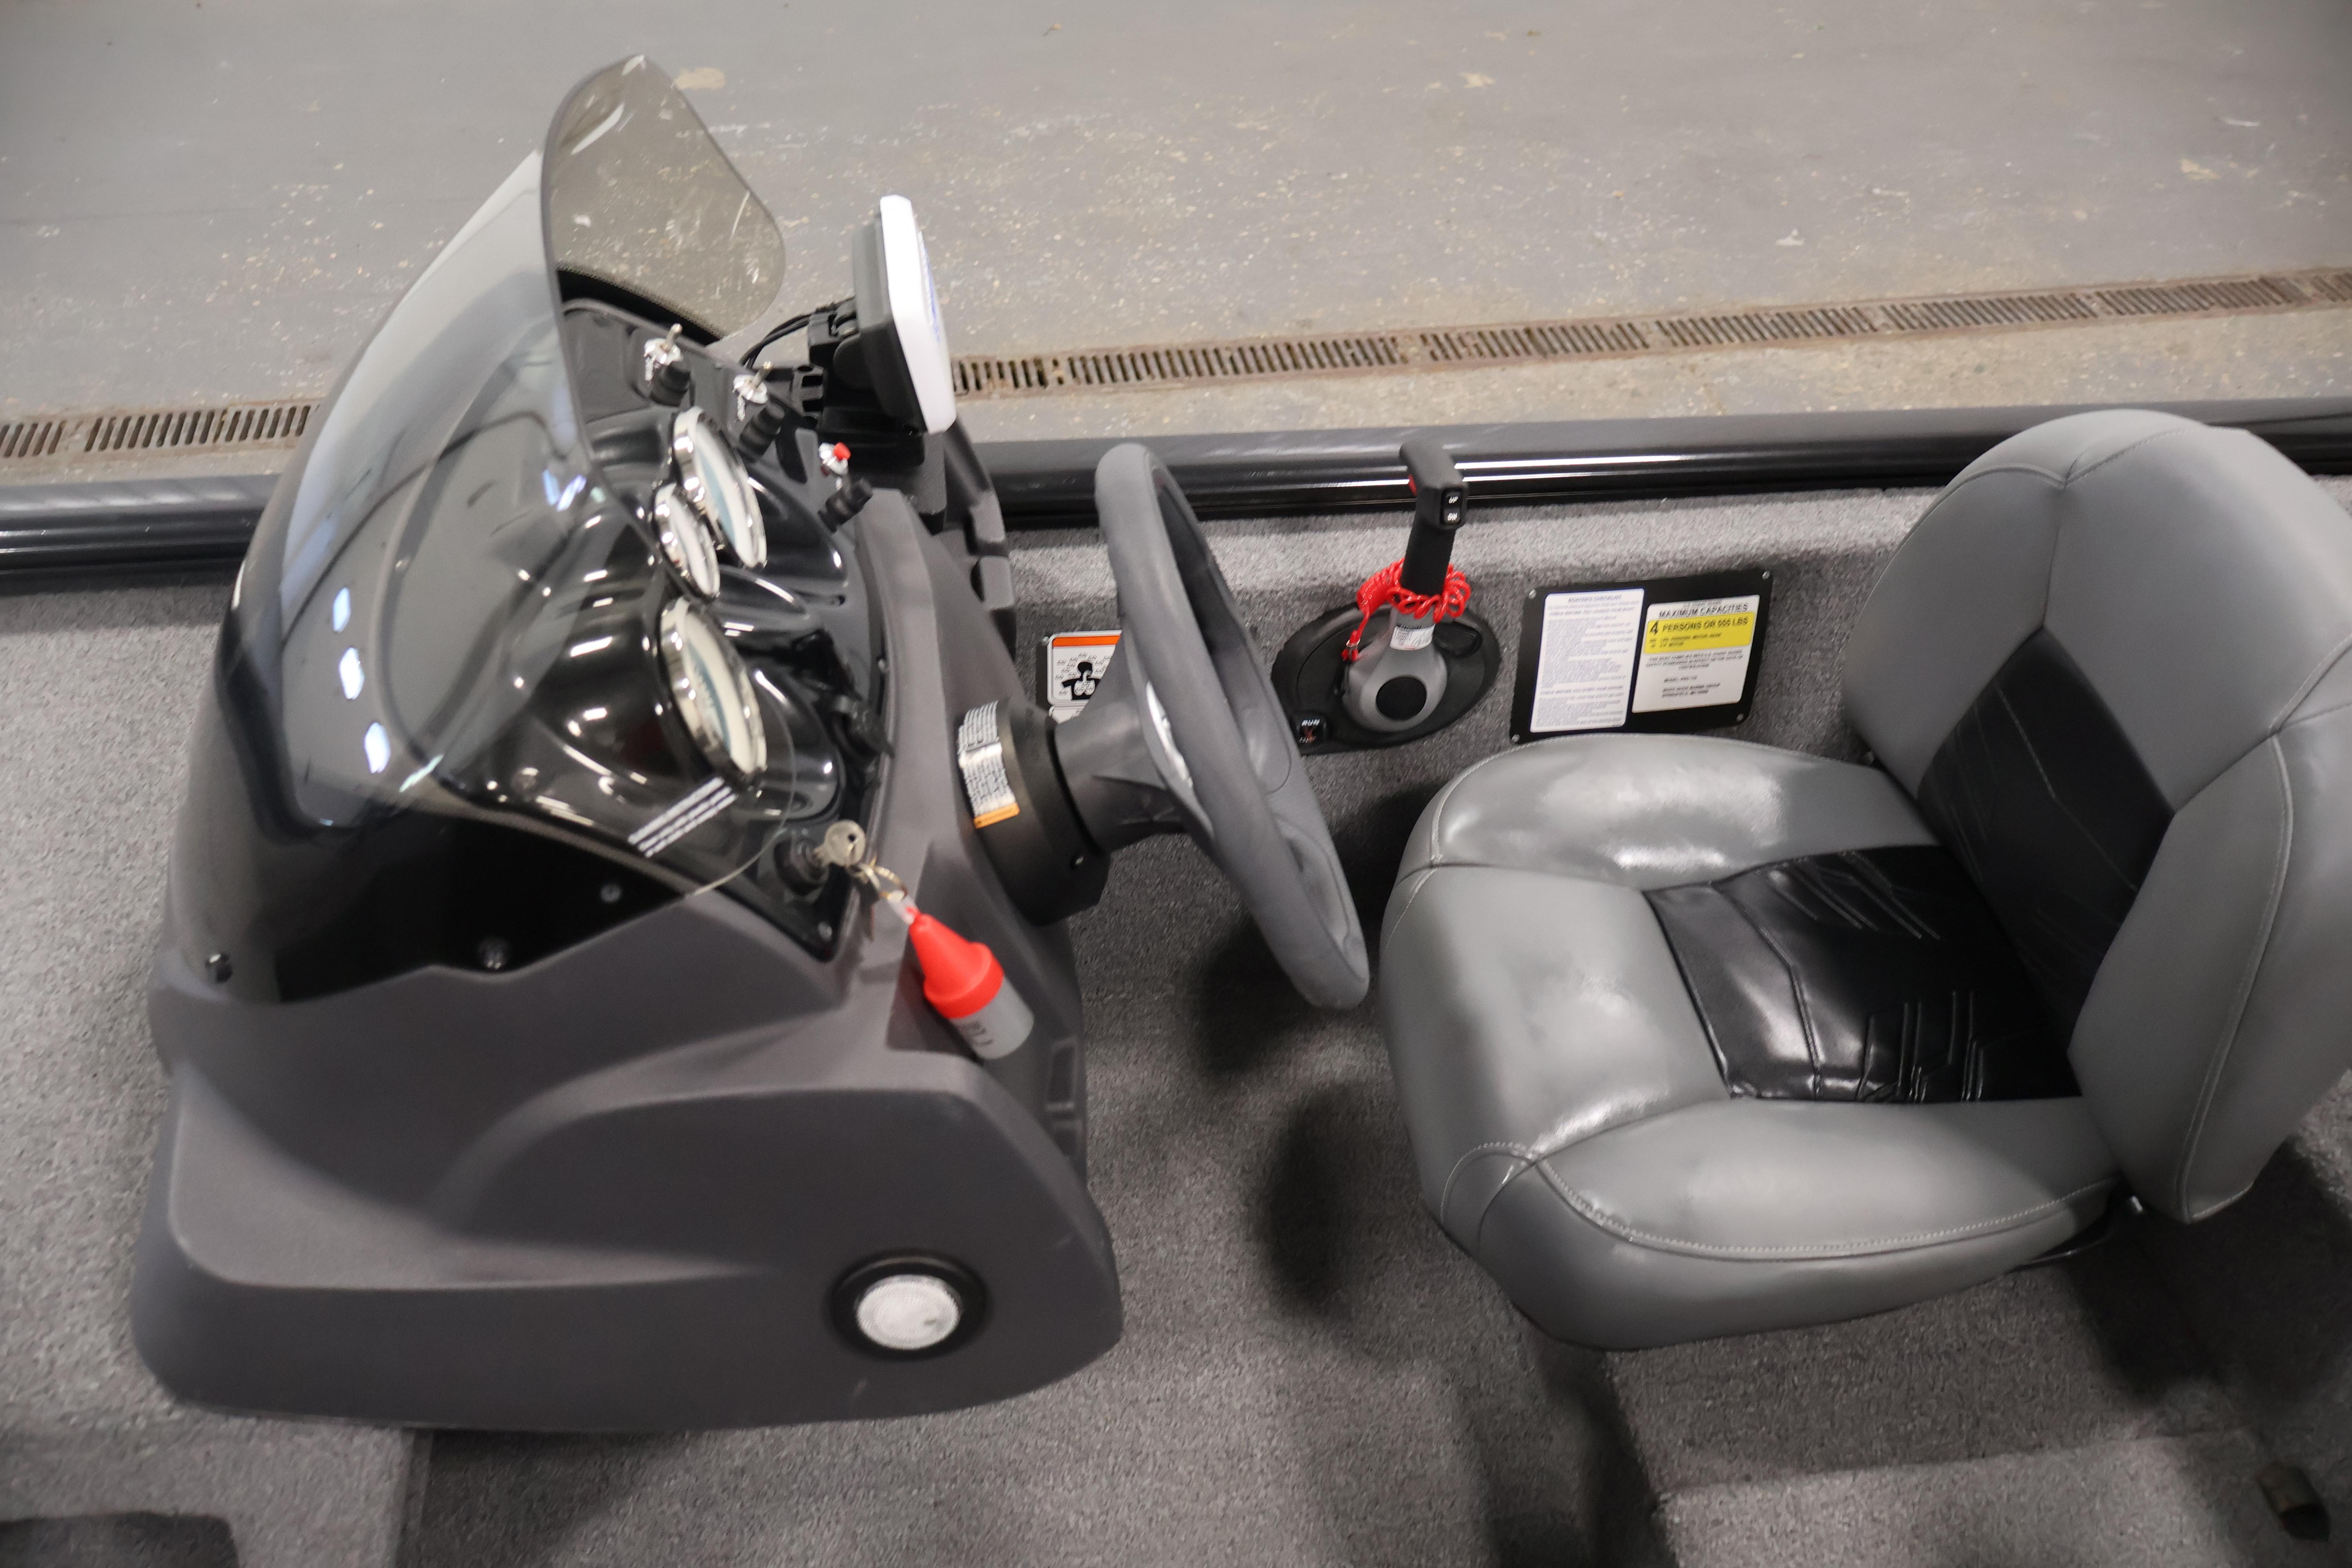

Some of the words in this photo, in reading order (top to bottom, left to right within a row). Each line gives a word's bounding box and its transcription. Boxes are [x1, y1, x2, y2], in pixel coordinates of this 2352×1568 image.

[1659, 608, 1698, 618] MAXIMUM
[1700, 603, 1748, 616] CAPACITIES
[1650, 621, 1659, 635] 4
[1662, 621, 1701, 633] PERSONS
[1705, 620, 1715, 630] OR
[1731, 616, 1748, 626] LBS
